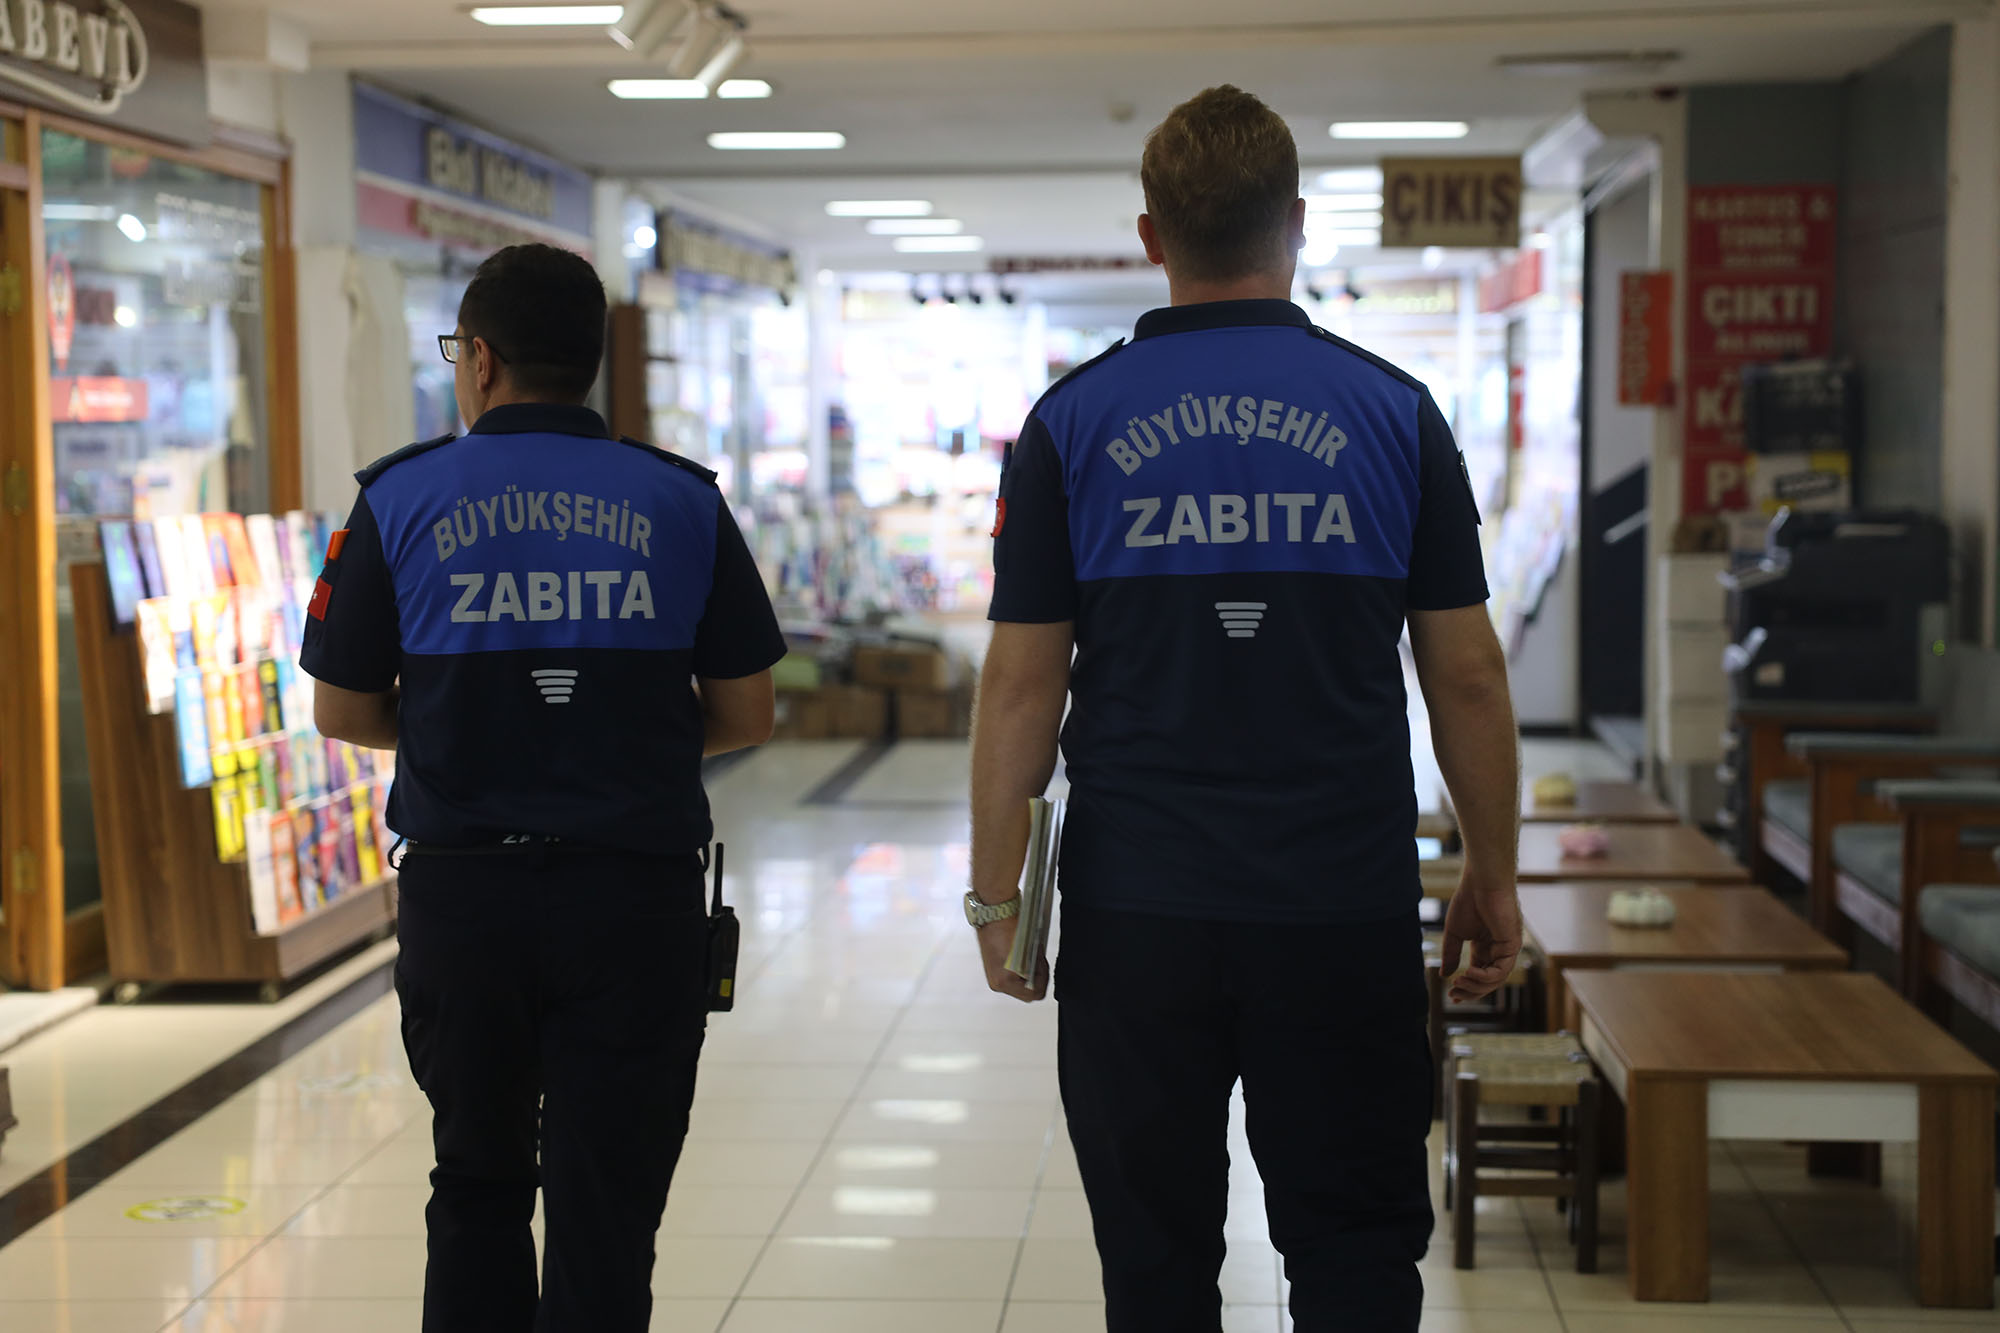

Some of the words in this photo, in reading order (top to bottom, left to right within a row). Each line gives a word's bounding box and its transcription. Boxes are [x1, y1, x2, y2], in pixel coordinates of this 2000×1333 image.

[1391, 171, 1516, 239] ÇIKIŞ
[1703, 284, 1817, 330] ÇIKTI
[1105, 392, 1349, 476] BÜYÜKŞEHİR
[432, 484, 652, 563] BÜYÜKŞEHİR
[1122, 493, 1357, 548] ZABITA
[449, 570, 656, 623] ZABITA
